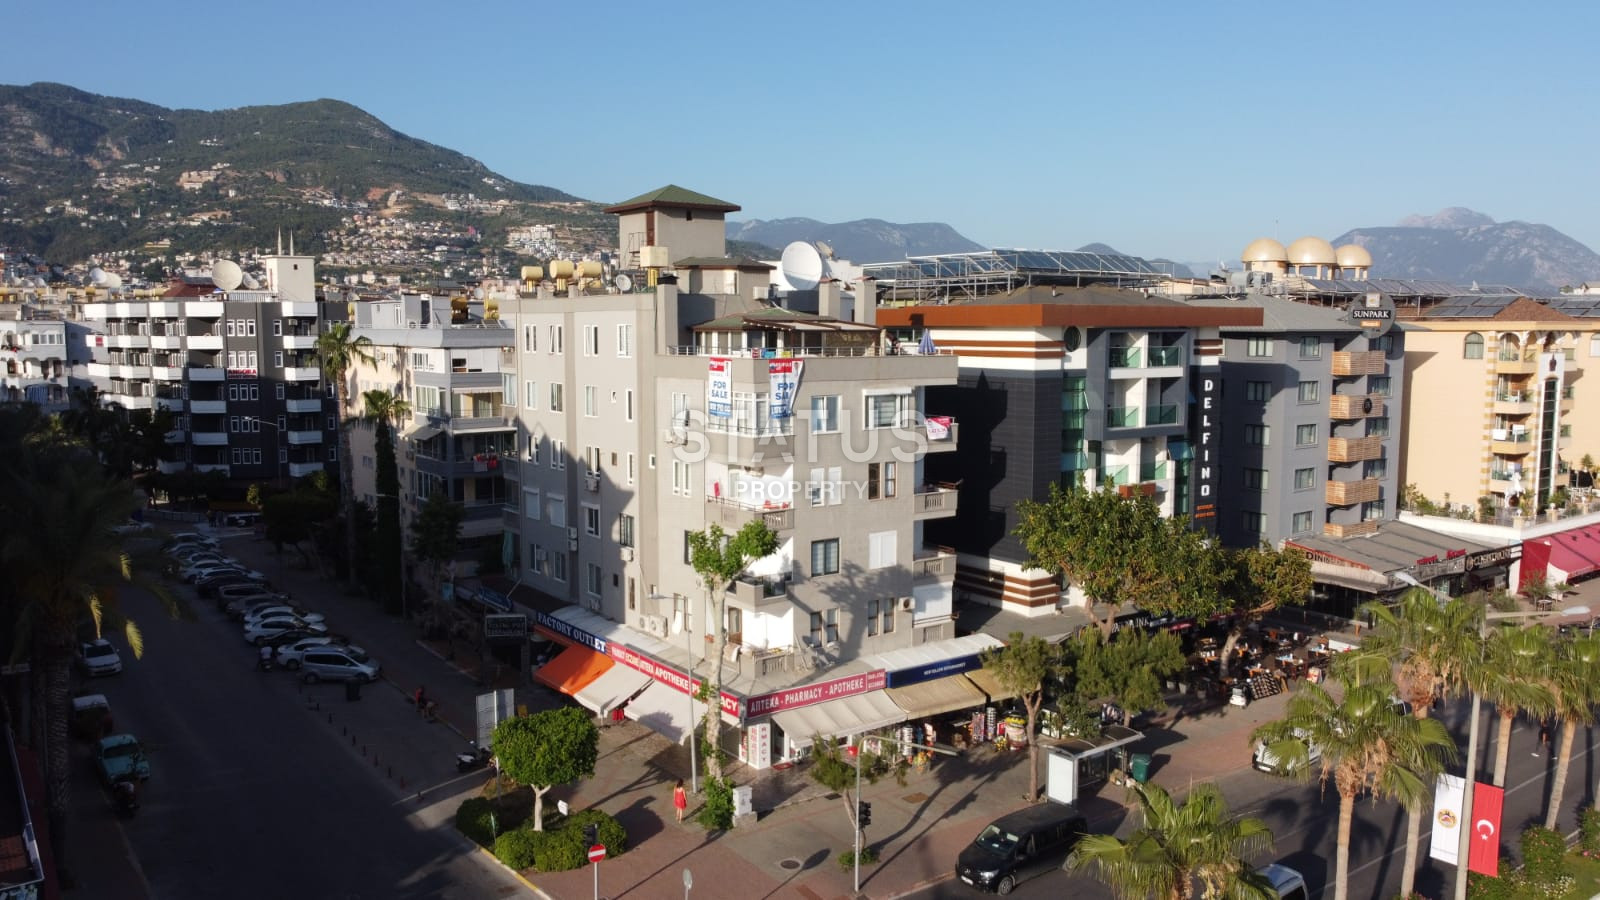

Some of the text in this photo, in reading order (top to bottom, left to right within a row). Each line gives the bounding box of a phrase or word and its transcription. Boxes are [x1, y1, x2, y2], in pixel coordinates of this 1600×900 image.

[1353, 310, 1389, 318] SUNPARK
[711, 389, 728, 400] SALE
[713, 381, 727, 390] FOR
[1200, 379, 1214, 497] DELFINO
[537, 612, 574, 637] FACTORY
[573, 629, 606, 653] OUTLET
[655, 667, 689, 691] APOTHEKE
[785, 688, 823, 705] PHARMACY
[829, 679, 865, 695] APOTHEKE
